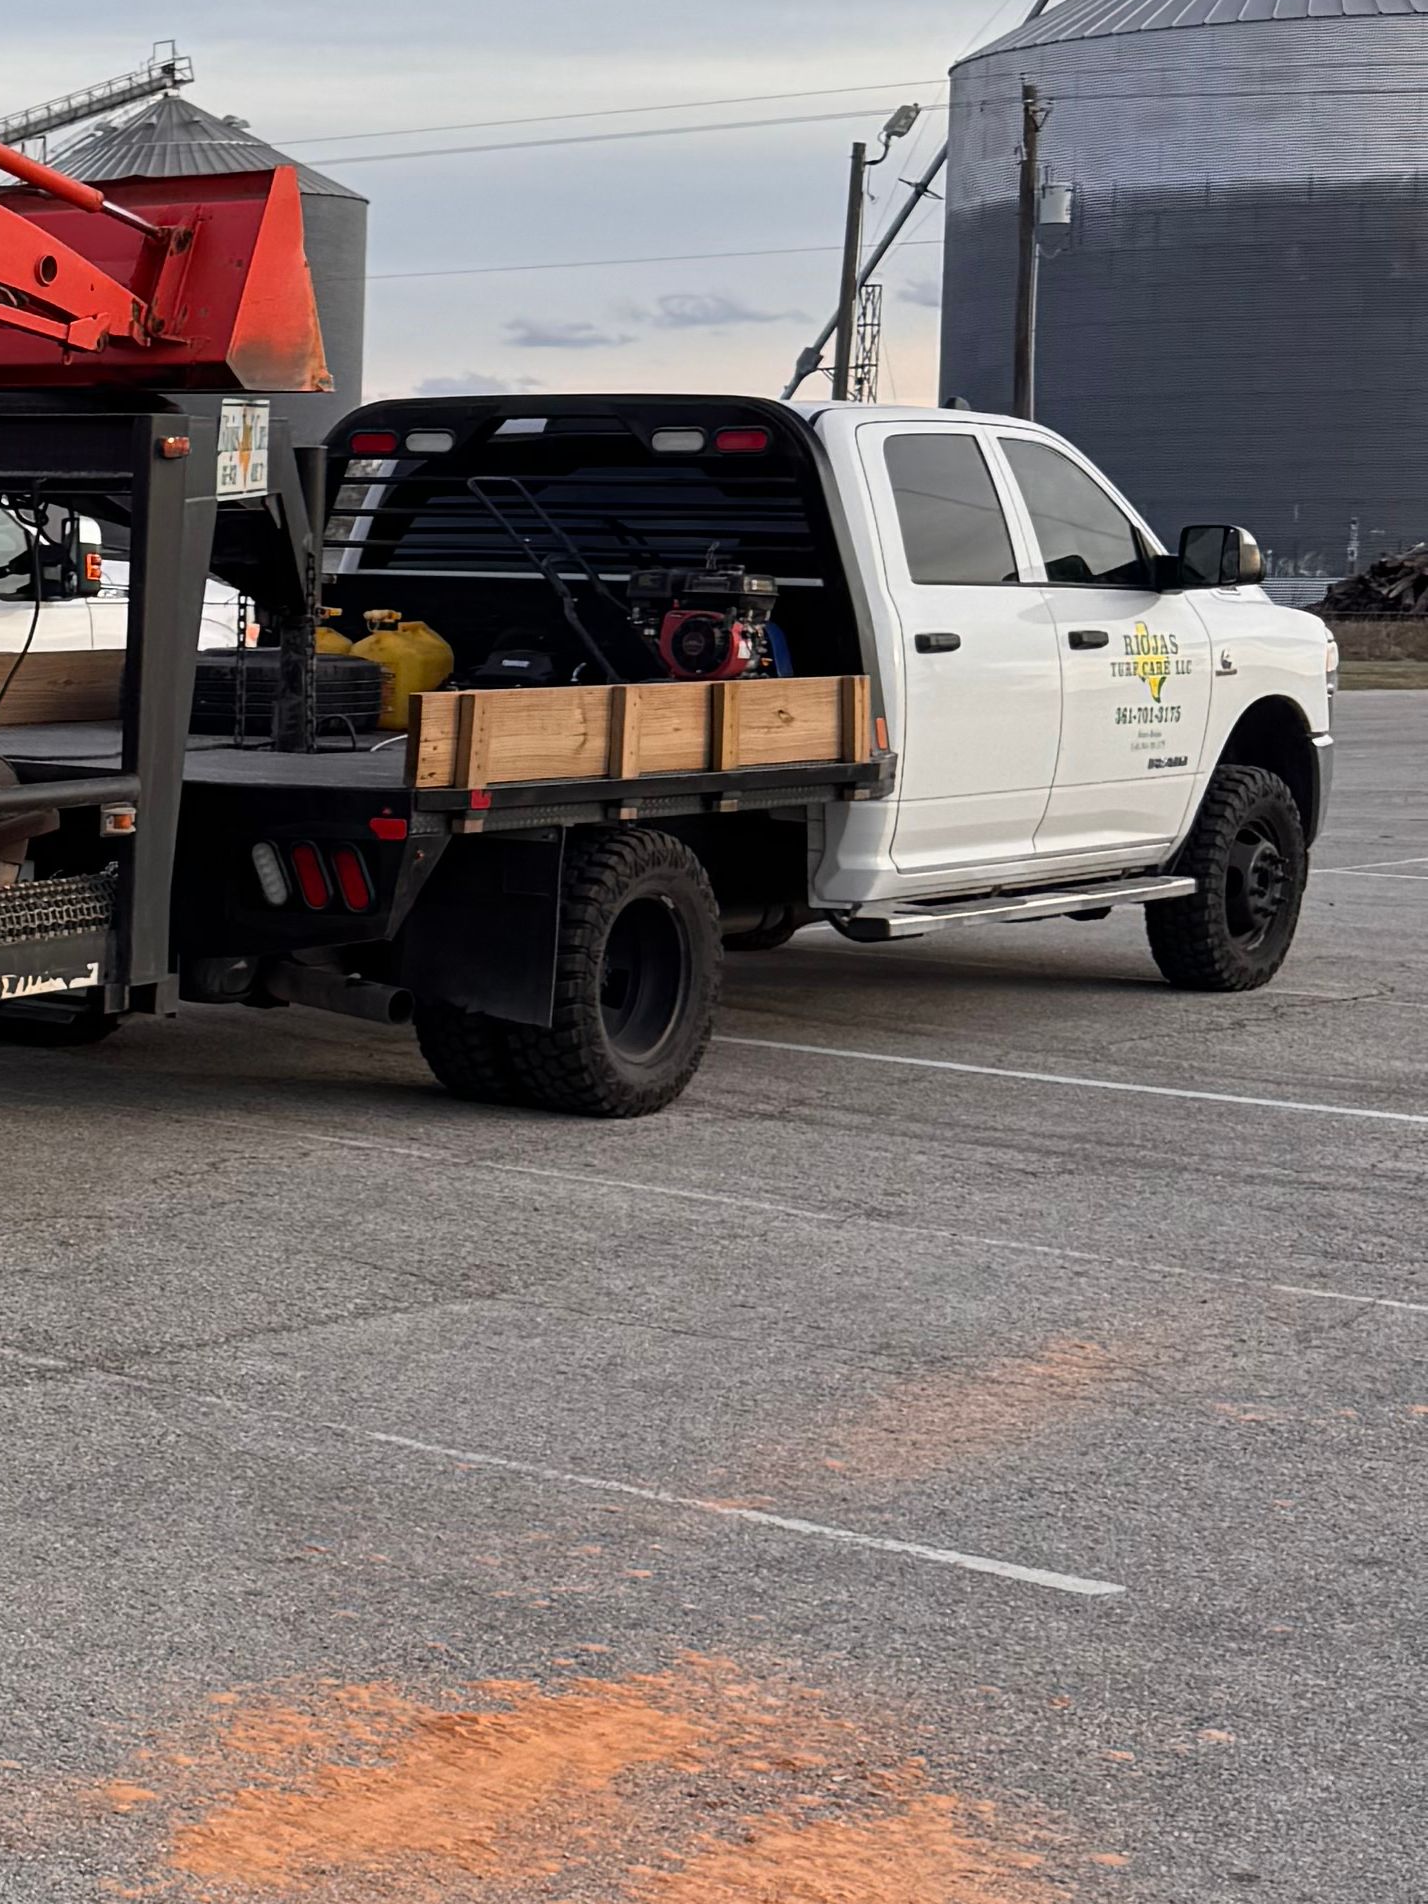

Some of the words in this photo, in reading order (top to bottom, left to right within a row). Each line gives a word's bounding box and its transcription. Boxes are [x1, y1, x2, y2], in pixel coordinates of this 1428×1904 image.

[1123, 634, 1179, 656] RIOJAS
[1110, 661, 1139, 677] TURF
[1142, 660, 1170, 675] CARE
[1175, 659, 1192, 675] LLC
[1115, 705, 1181, 725] 361-701-3175
